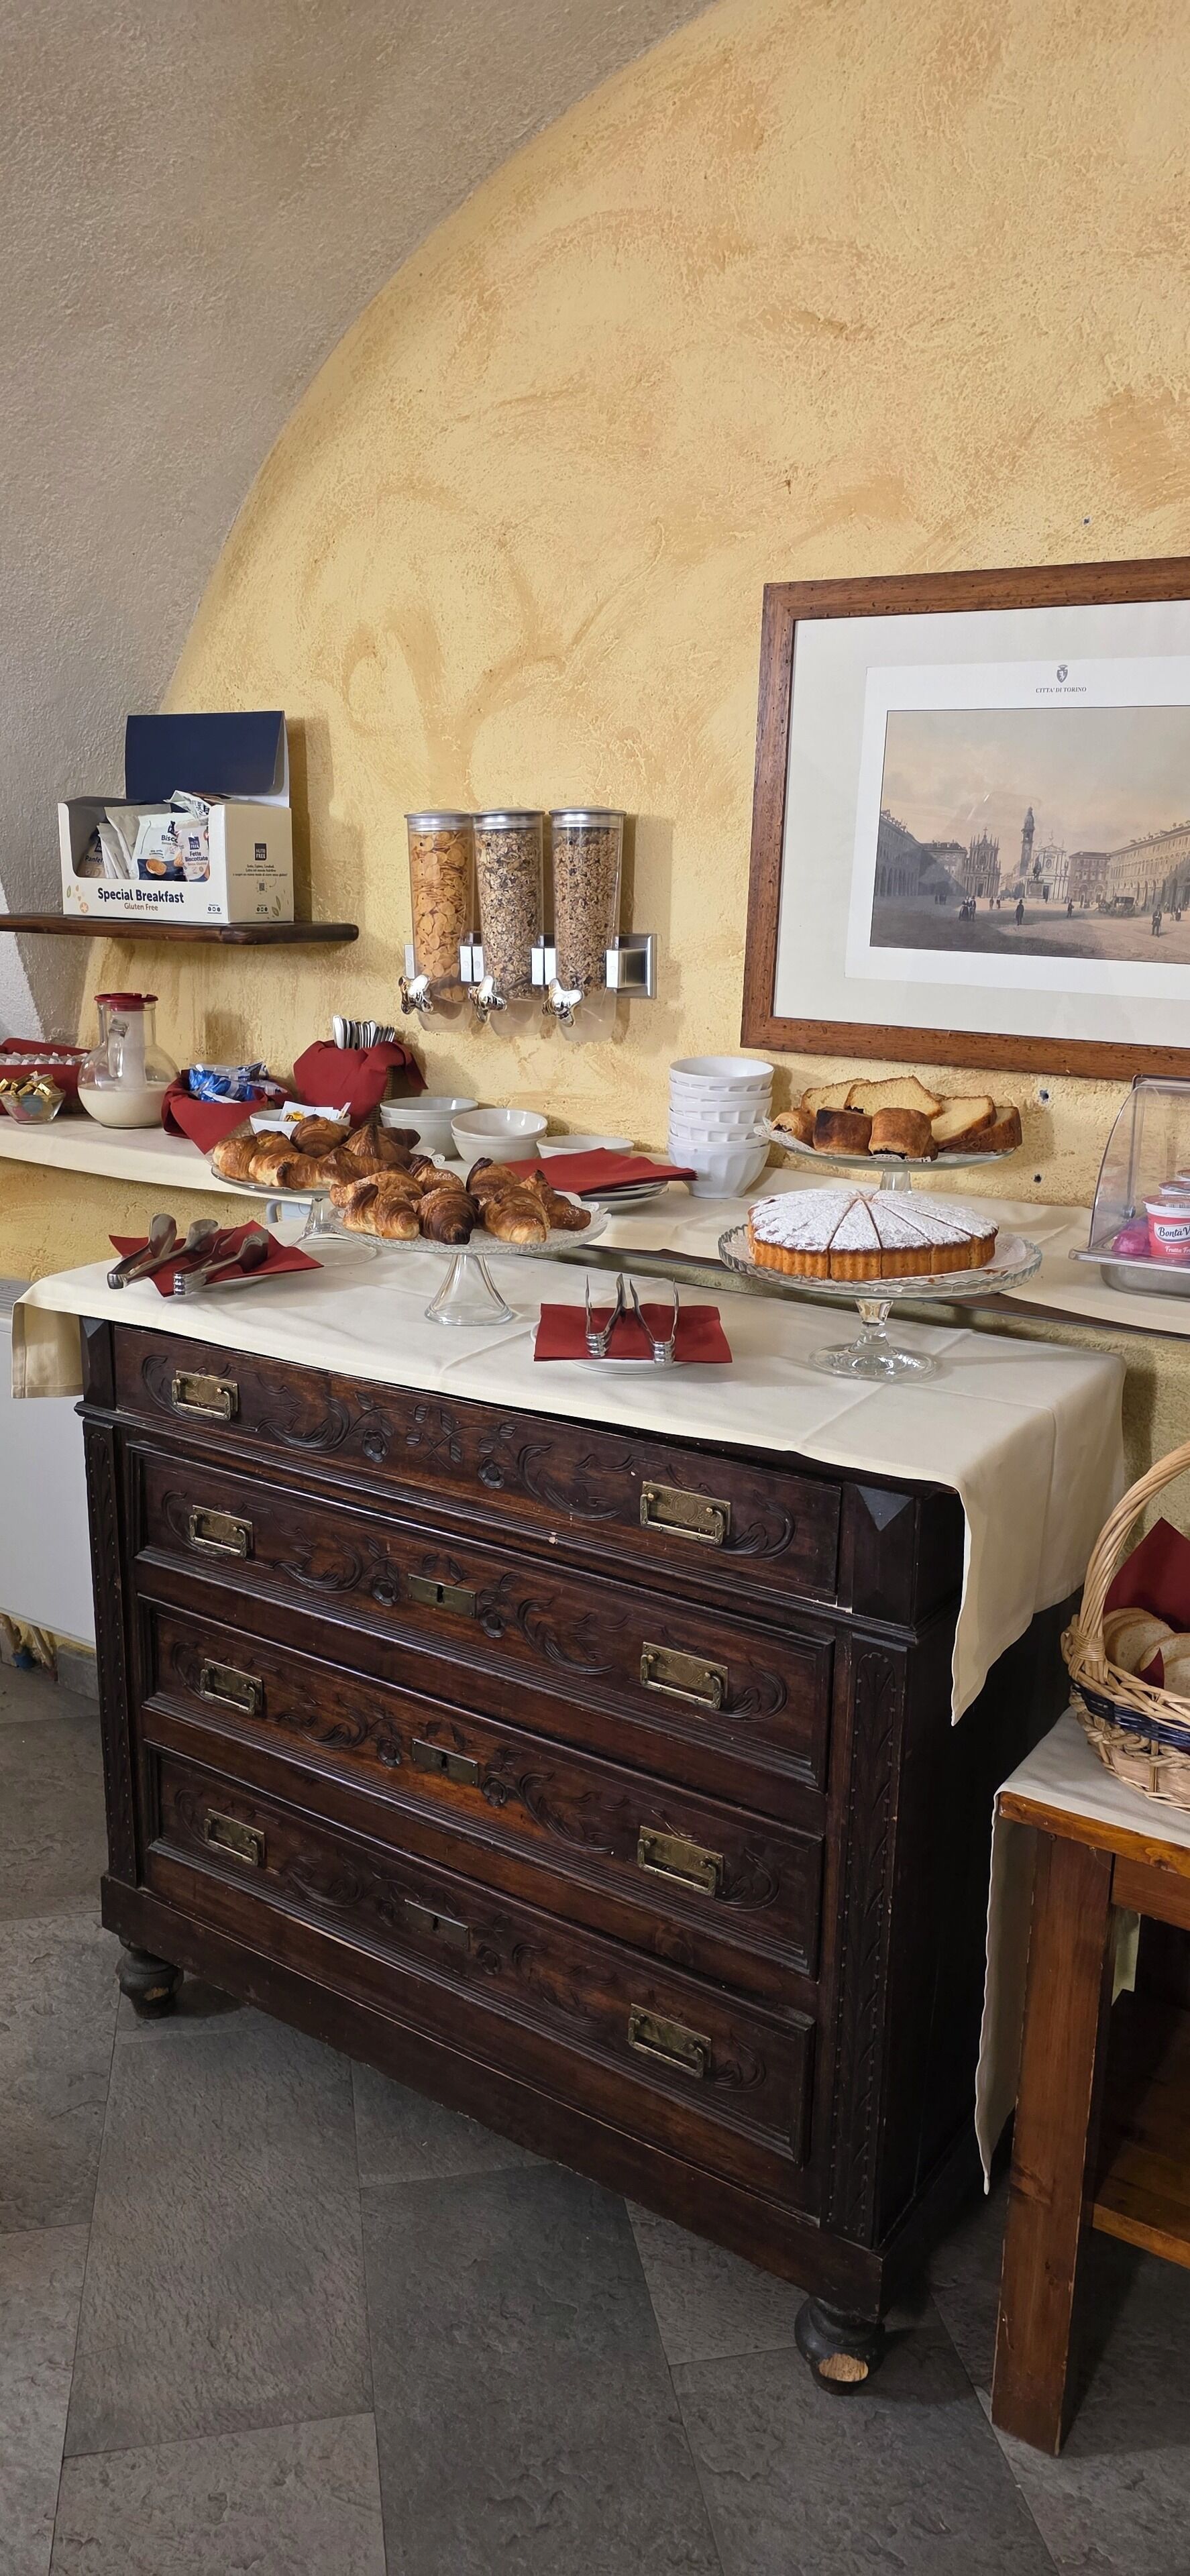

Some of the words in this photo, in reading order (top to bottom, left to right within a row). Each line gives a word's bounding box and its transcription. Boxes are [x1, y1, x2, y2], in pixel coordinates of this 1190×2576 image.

[97, 888, 133, 902] Special
[136, 890, 184, 903] Breakfast
[124, 902, 144, 910] Gluten
[1158, 1227, 1183, 1238] Bontà
